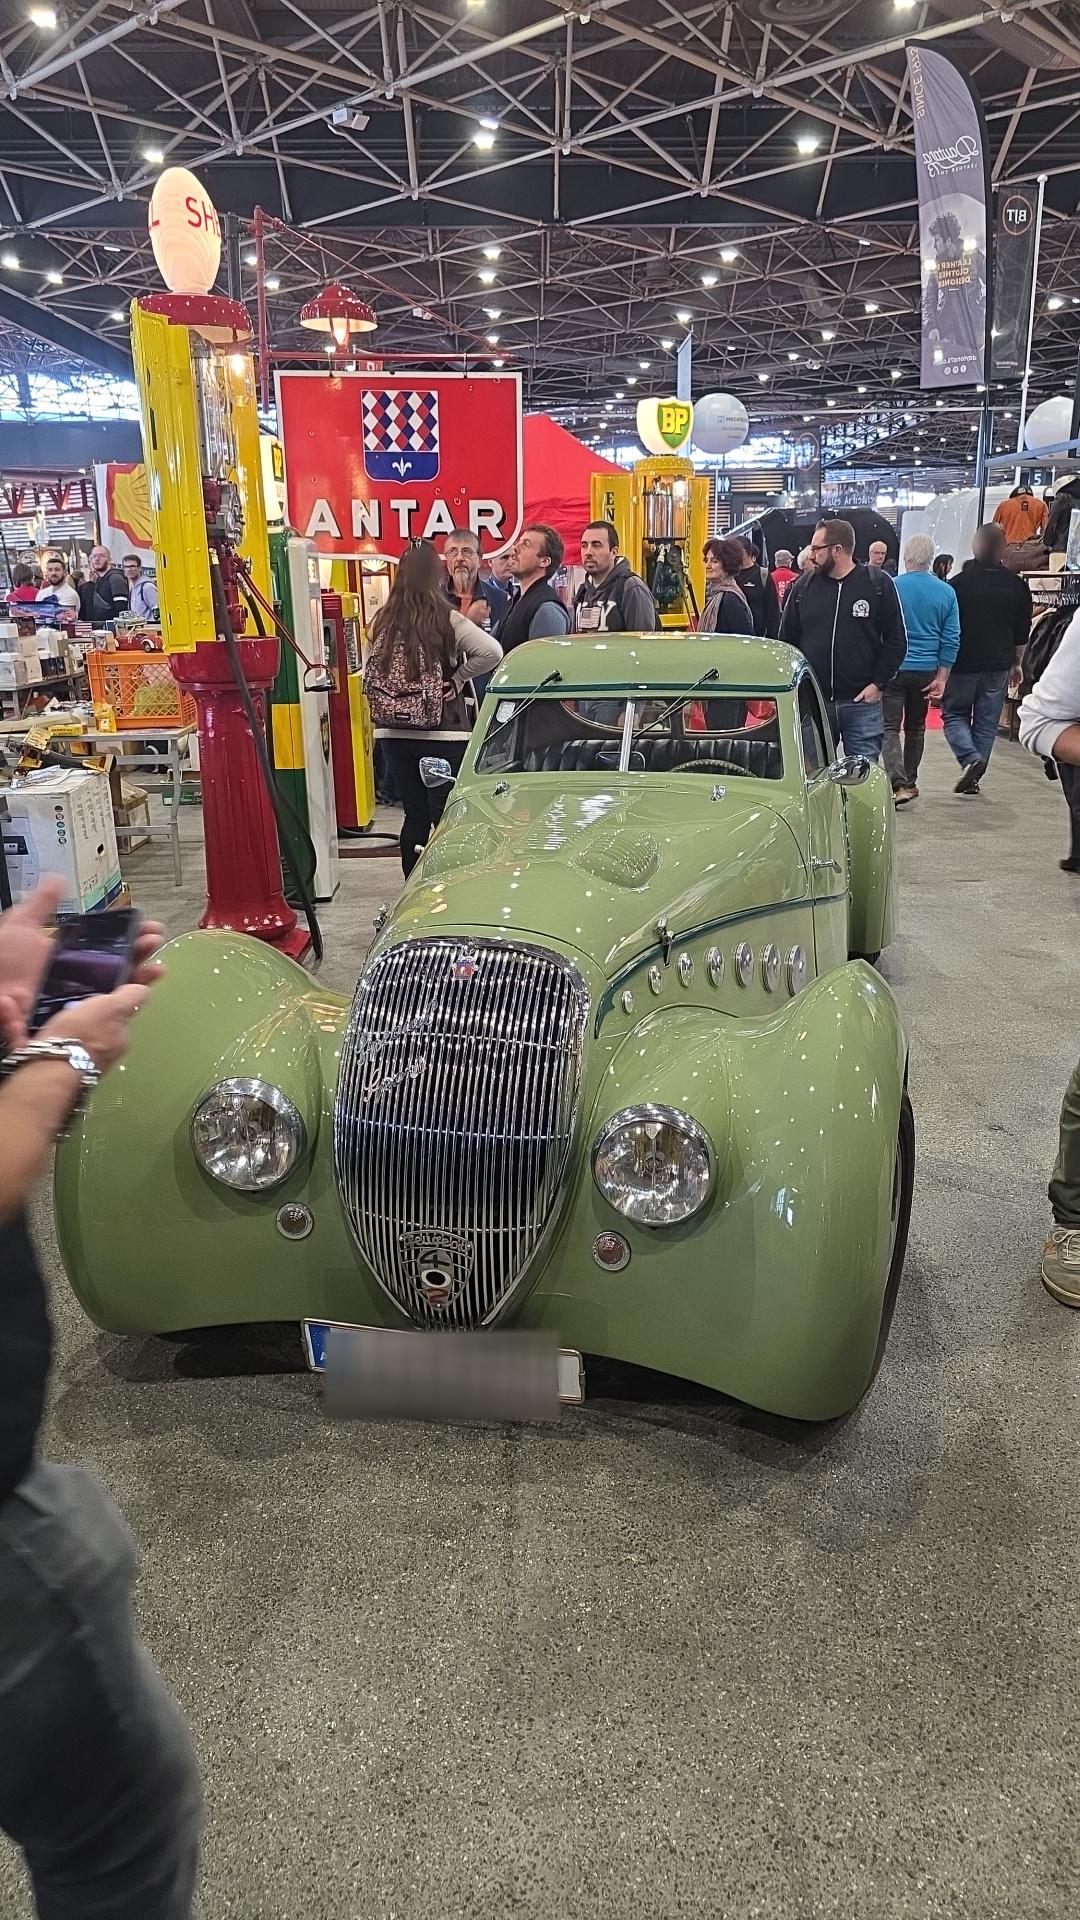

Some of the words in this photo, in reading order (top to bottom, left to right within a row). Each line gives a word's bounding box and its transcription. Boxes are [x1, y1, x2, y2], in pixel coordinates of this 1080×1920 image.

[661, 407, 689, 435] BP
[1034, 473, 1042, 486] 5
[305, 498, 505, 541] ANTAR
